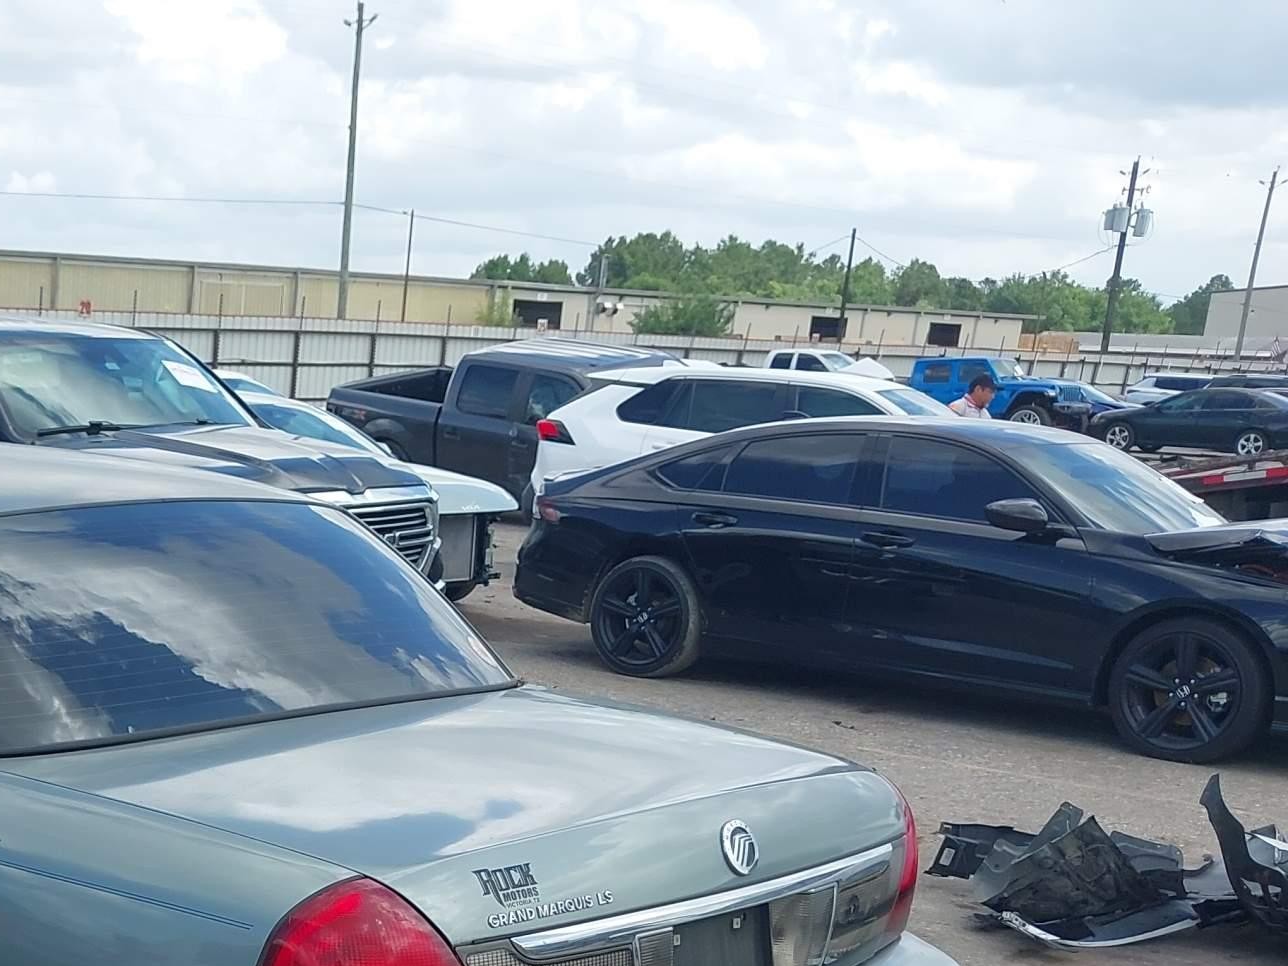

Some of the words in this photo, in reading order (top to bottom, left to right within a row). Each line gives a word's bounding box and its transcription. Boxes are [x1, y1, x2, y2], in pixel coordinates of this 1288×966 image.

[472, 862, 538, 910] ROCK
[502, 886, 539, 902] MOTORS
[488, 908, 536, 928] GRAND
[536, 895, 594, 919] MARQUIS
[596, 889, 614, 905] LS
